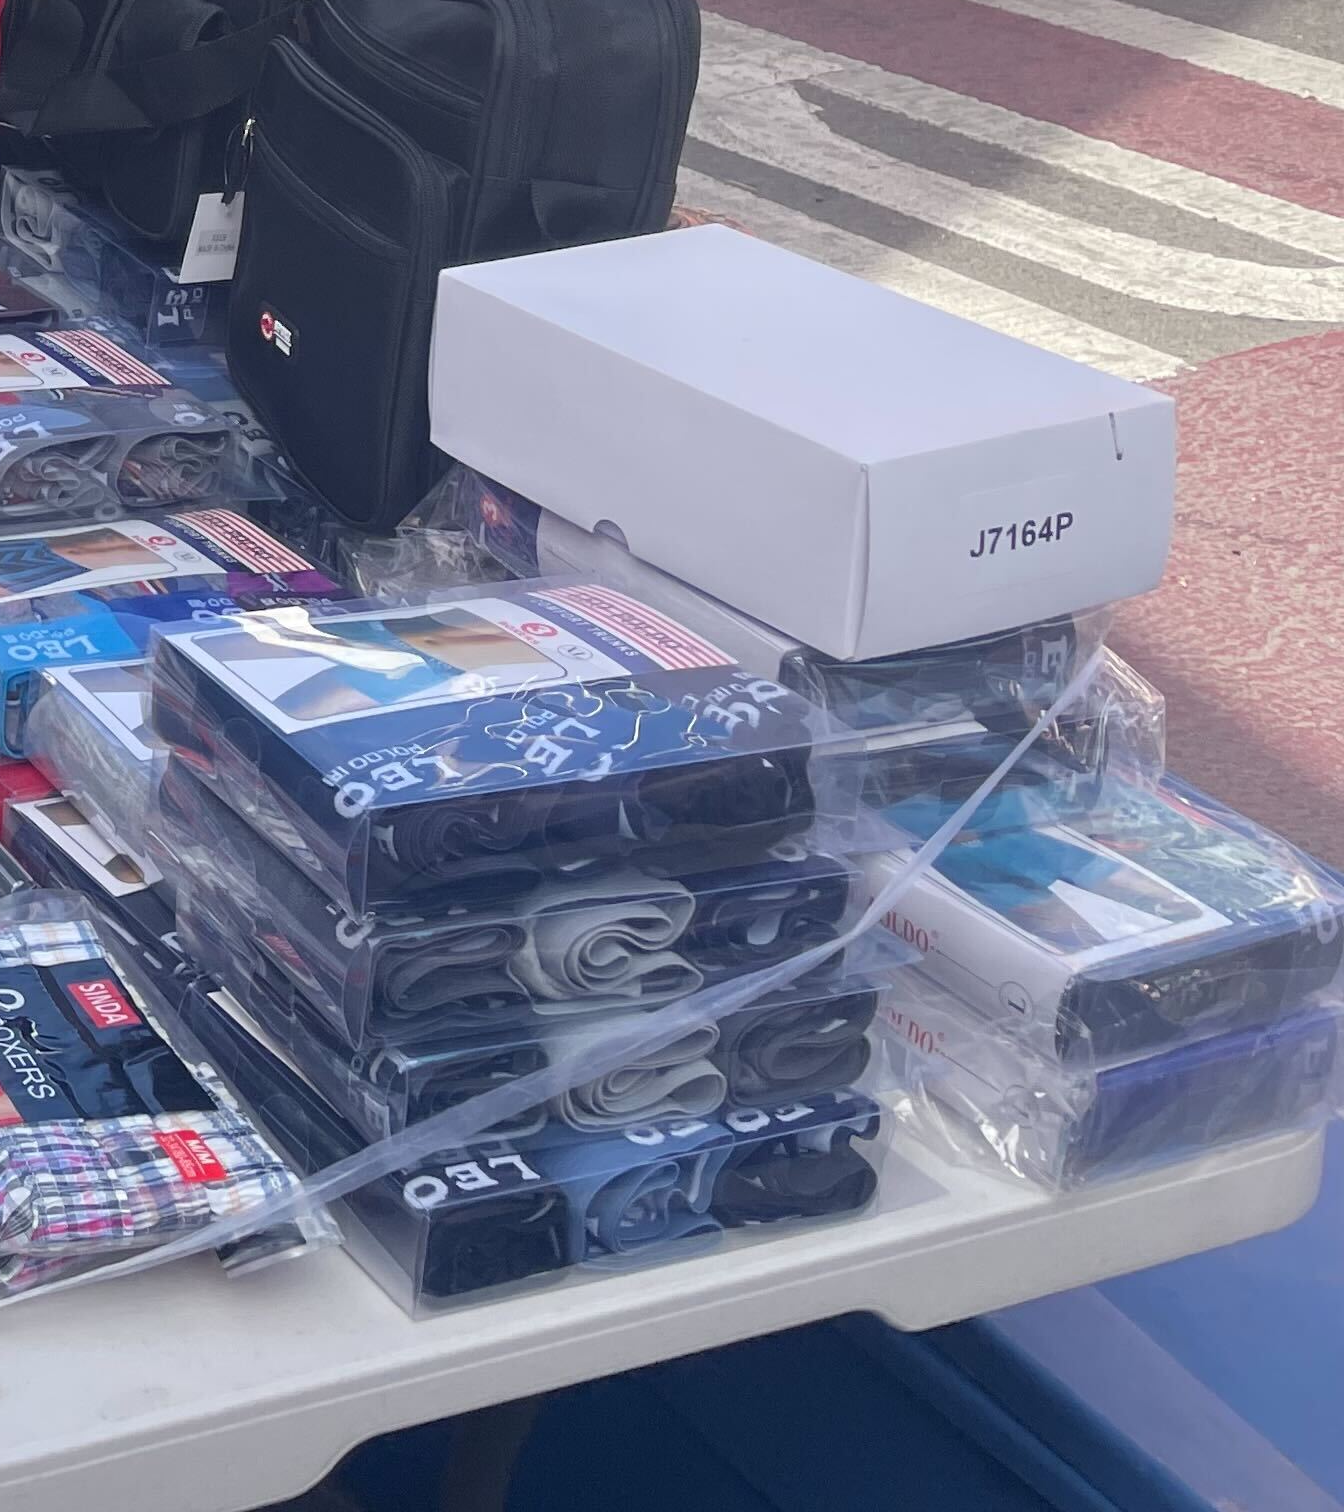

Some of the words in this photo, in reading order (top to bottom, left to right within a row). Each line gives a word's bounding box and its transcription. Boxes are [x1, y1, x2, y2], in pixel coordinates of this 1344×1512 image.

[970, 511, 1074, 559] J7164P
[7, 633, 102, 663] LEO
[585, 622, 641, 660] TRUNKS
[333, 754, 463, 819] LEO
[75, 981, 130, 1025] SINDA
[185, 1135, 215, 1168] M/M
[402, 1154, 541, 1210] LEO
